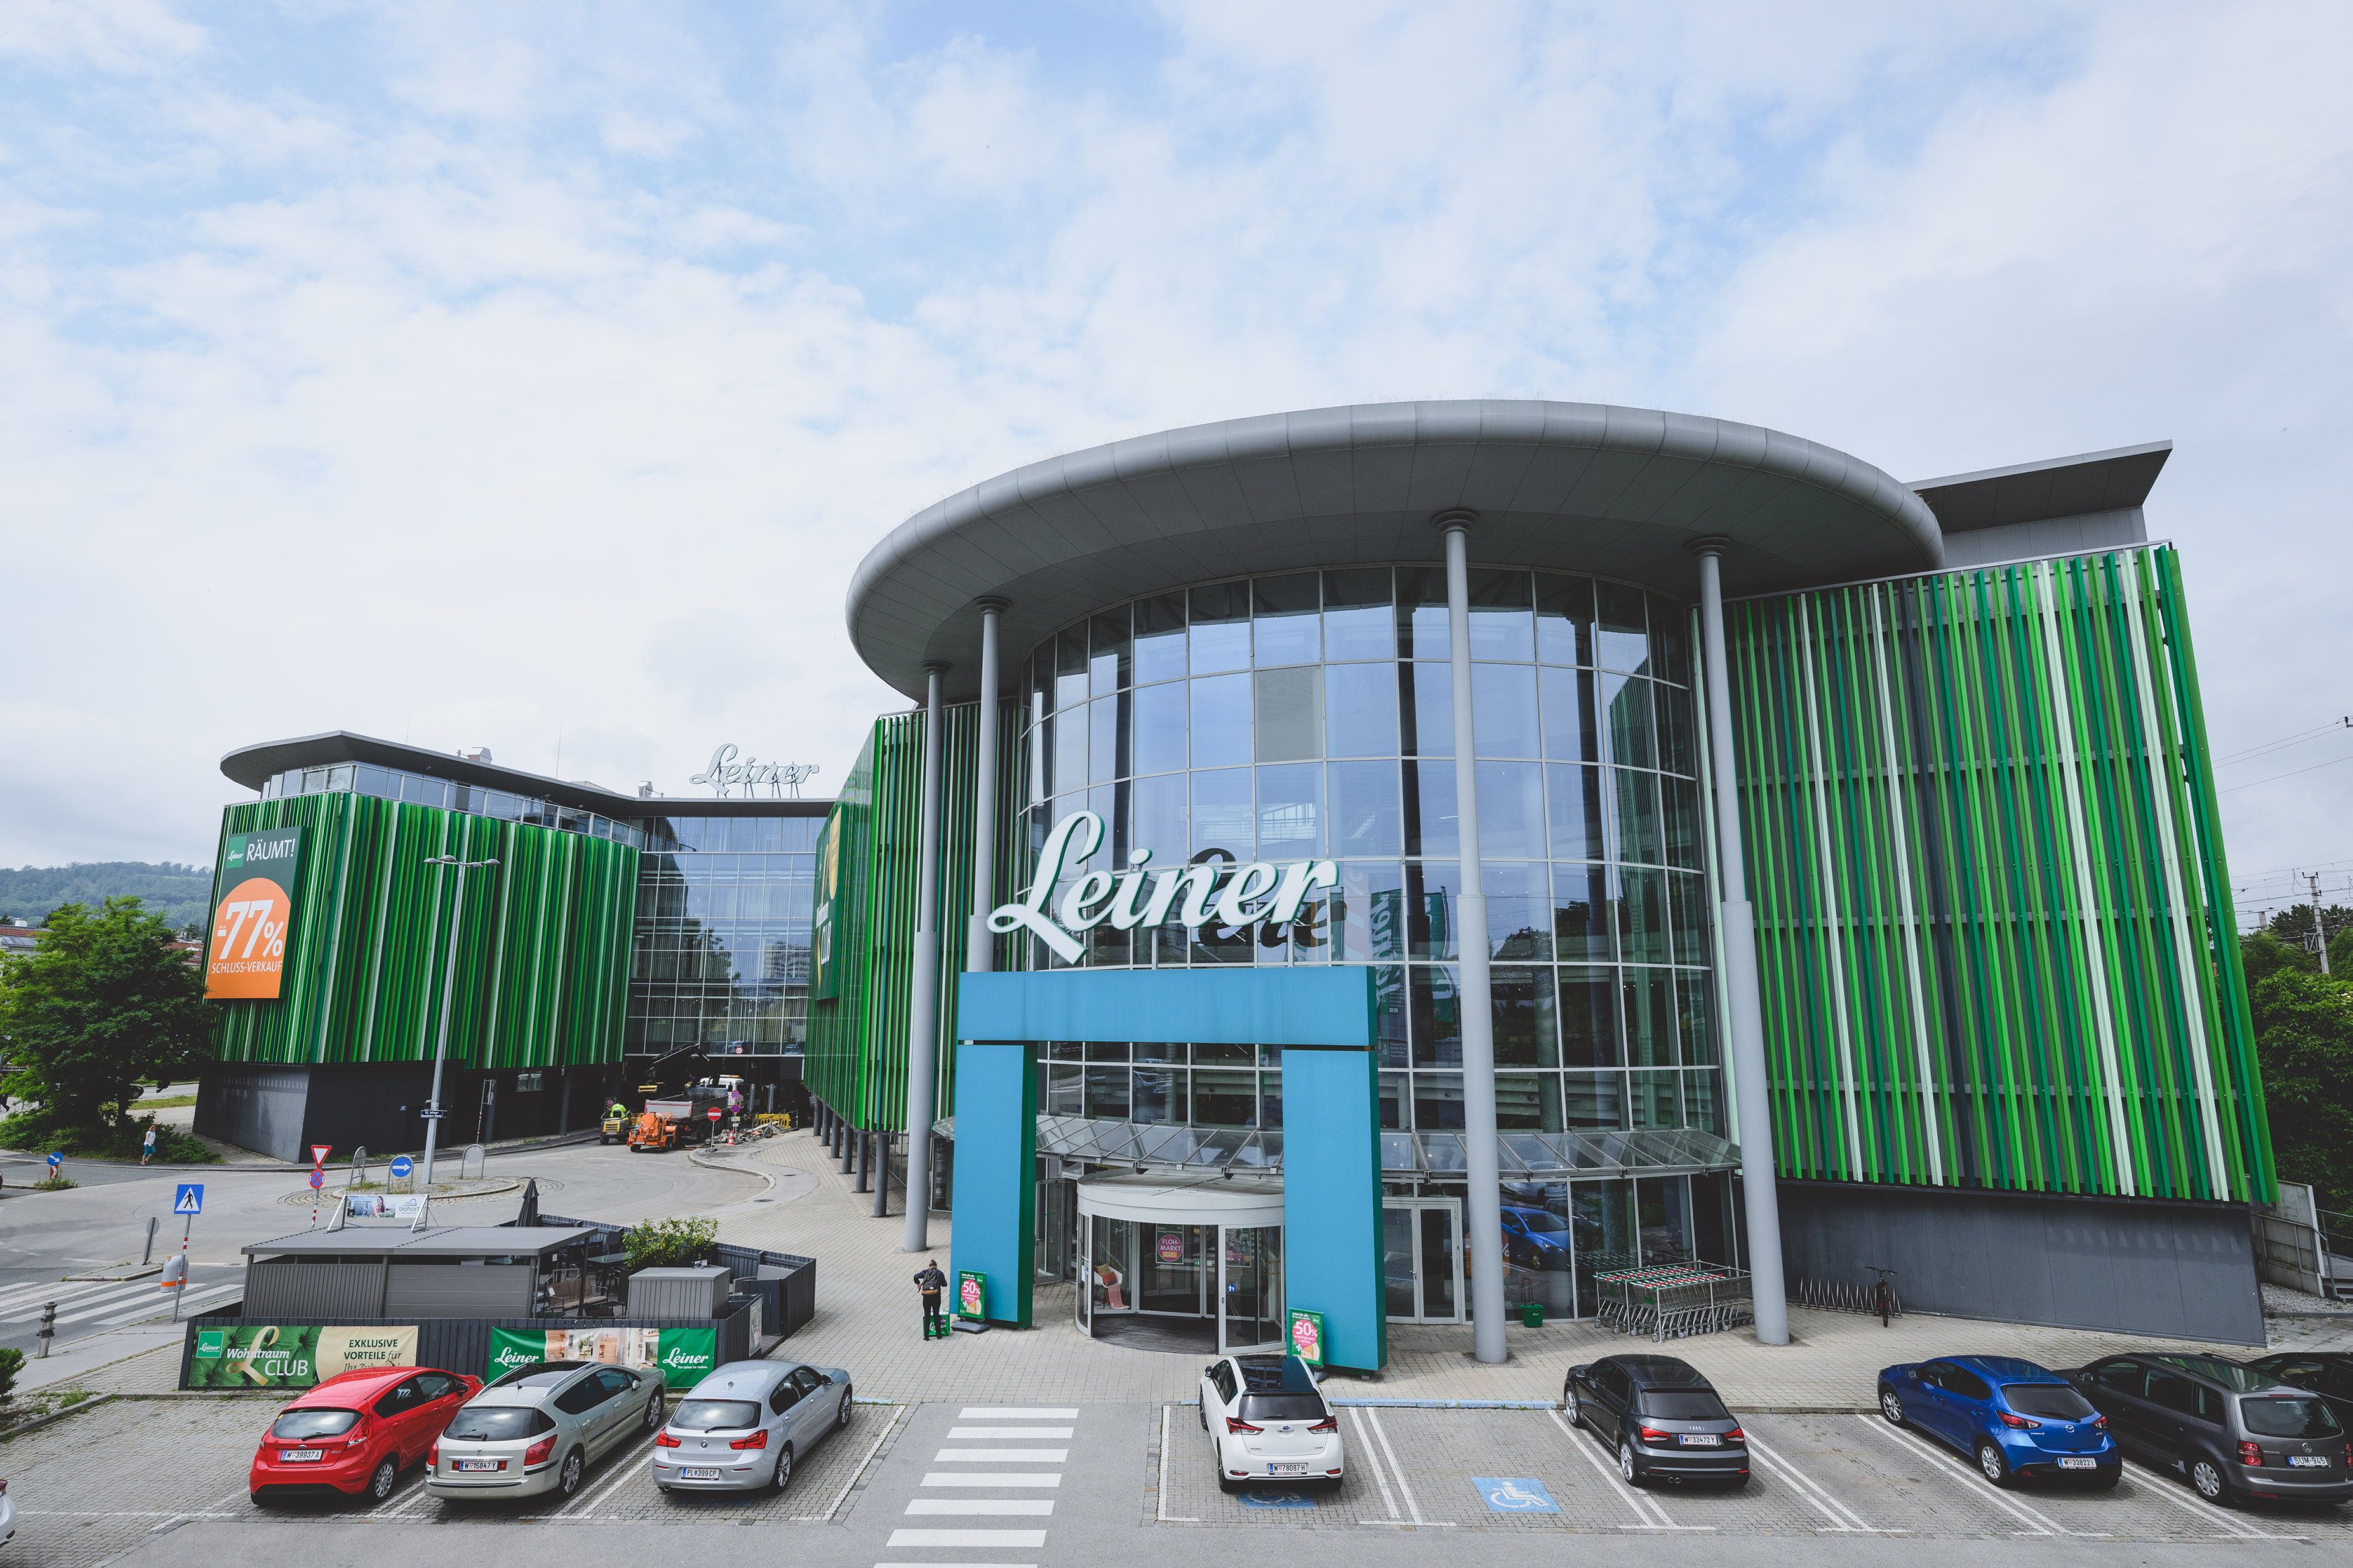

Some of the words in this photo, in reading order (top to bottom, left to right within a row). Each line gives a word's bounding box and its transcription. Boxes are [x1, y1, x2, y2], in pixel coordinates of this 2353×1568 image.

[689, 743, 820, 795] Leiner
[227, 850, 243, 862] Leiner
[246, 838, 296, 862] RÄUMT!
[986, 810, 1339, 965] Leiner
[217, 899, 284, 960] -77%
[212, 960, 282, 974] SCHLUSS-VERKAUF
[199, 1342, 221, 1352] Leiner
[349, 1339, 398, 1348] EXKLUSIVE
[227, 1348, 290, 1359] Wohntraum
[344, 1352, 386, 1360] VORTEILE
[385, 1351, 402, 1362] für
[494, 1347, 539, 1366] Leiner
[662, 1347, 709, 1368] Leiner
[265, 1360, 308, 1376] CLUB
[2294, 1456, 2325, 1464] SUM-945
